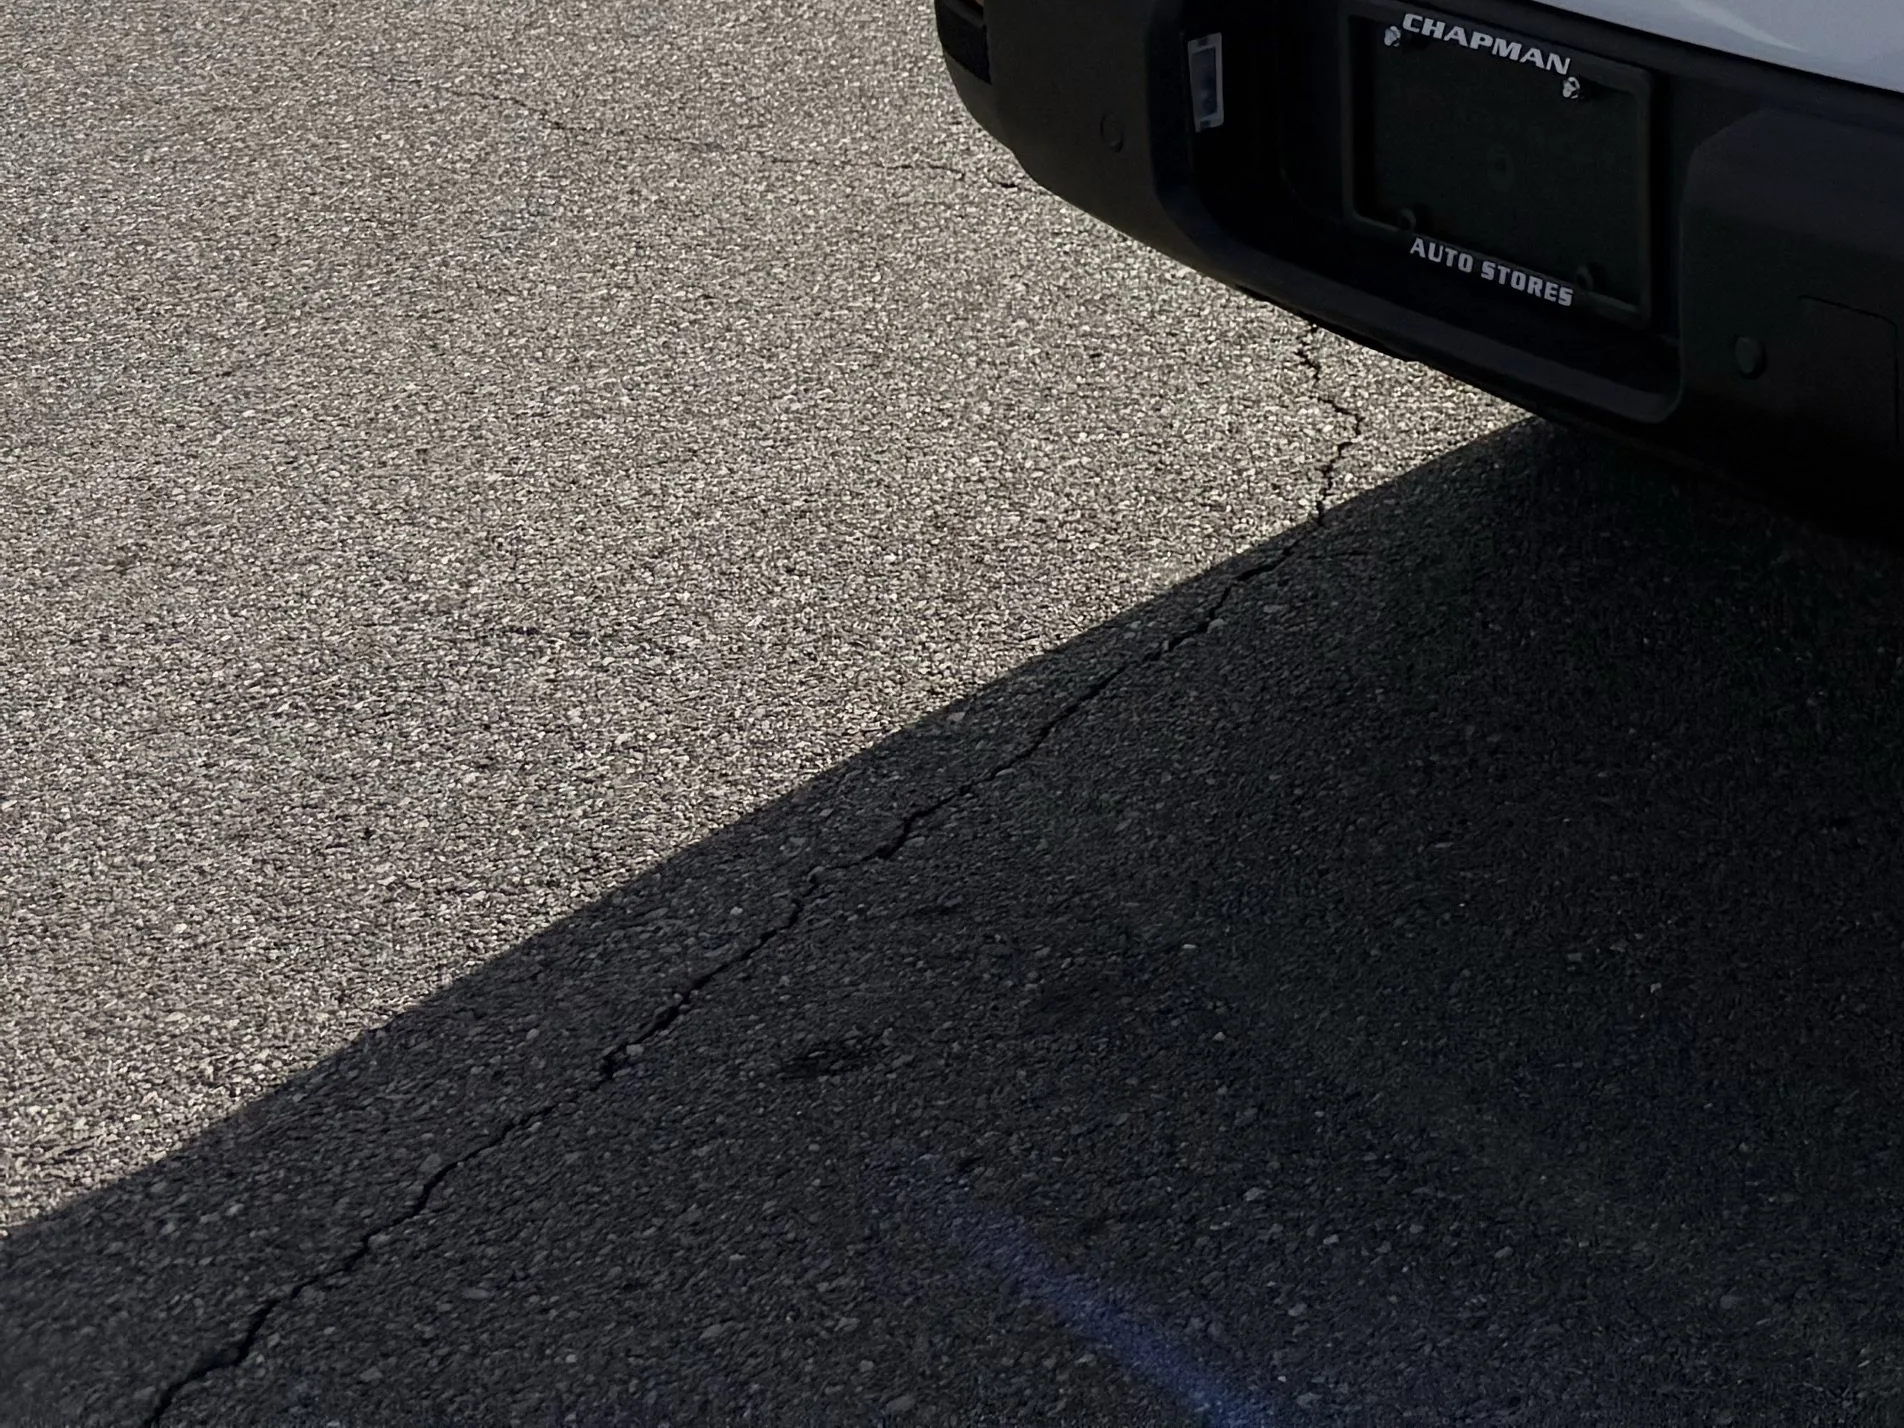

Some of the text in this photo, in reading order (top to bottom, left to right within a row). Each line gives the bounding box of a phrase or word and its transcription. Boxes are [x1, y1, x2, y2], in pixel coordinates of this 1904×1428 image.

[1402, 12, 1571, 76] CHAPMAN
[1409, 236, 1575, 308] AUTO STORES
